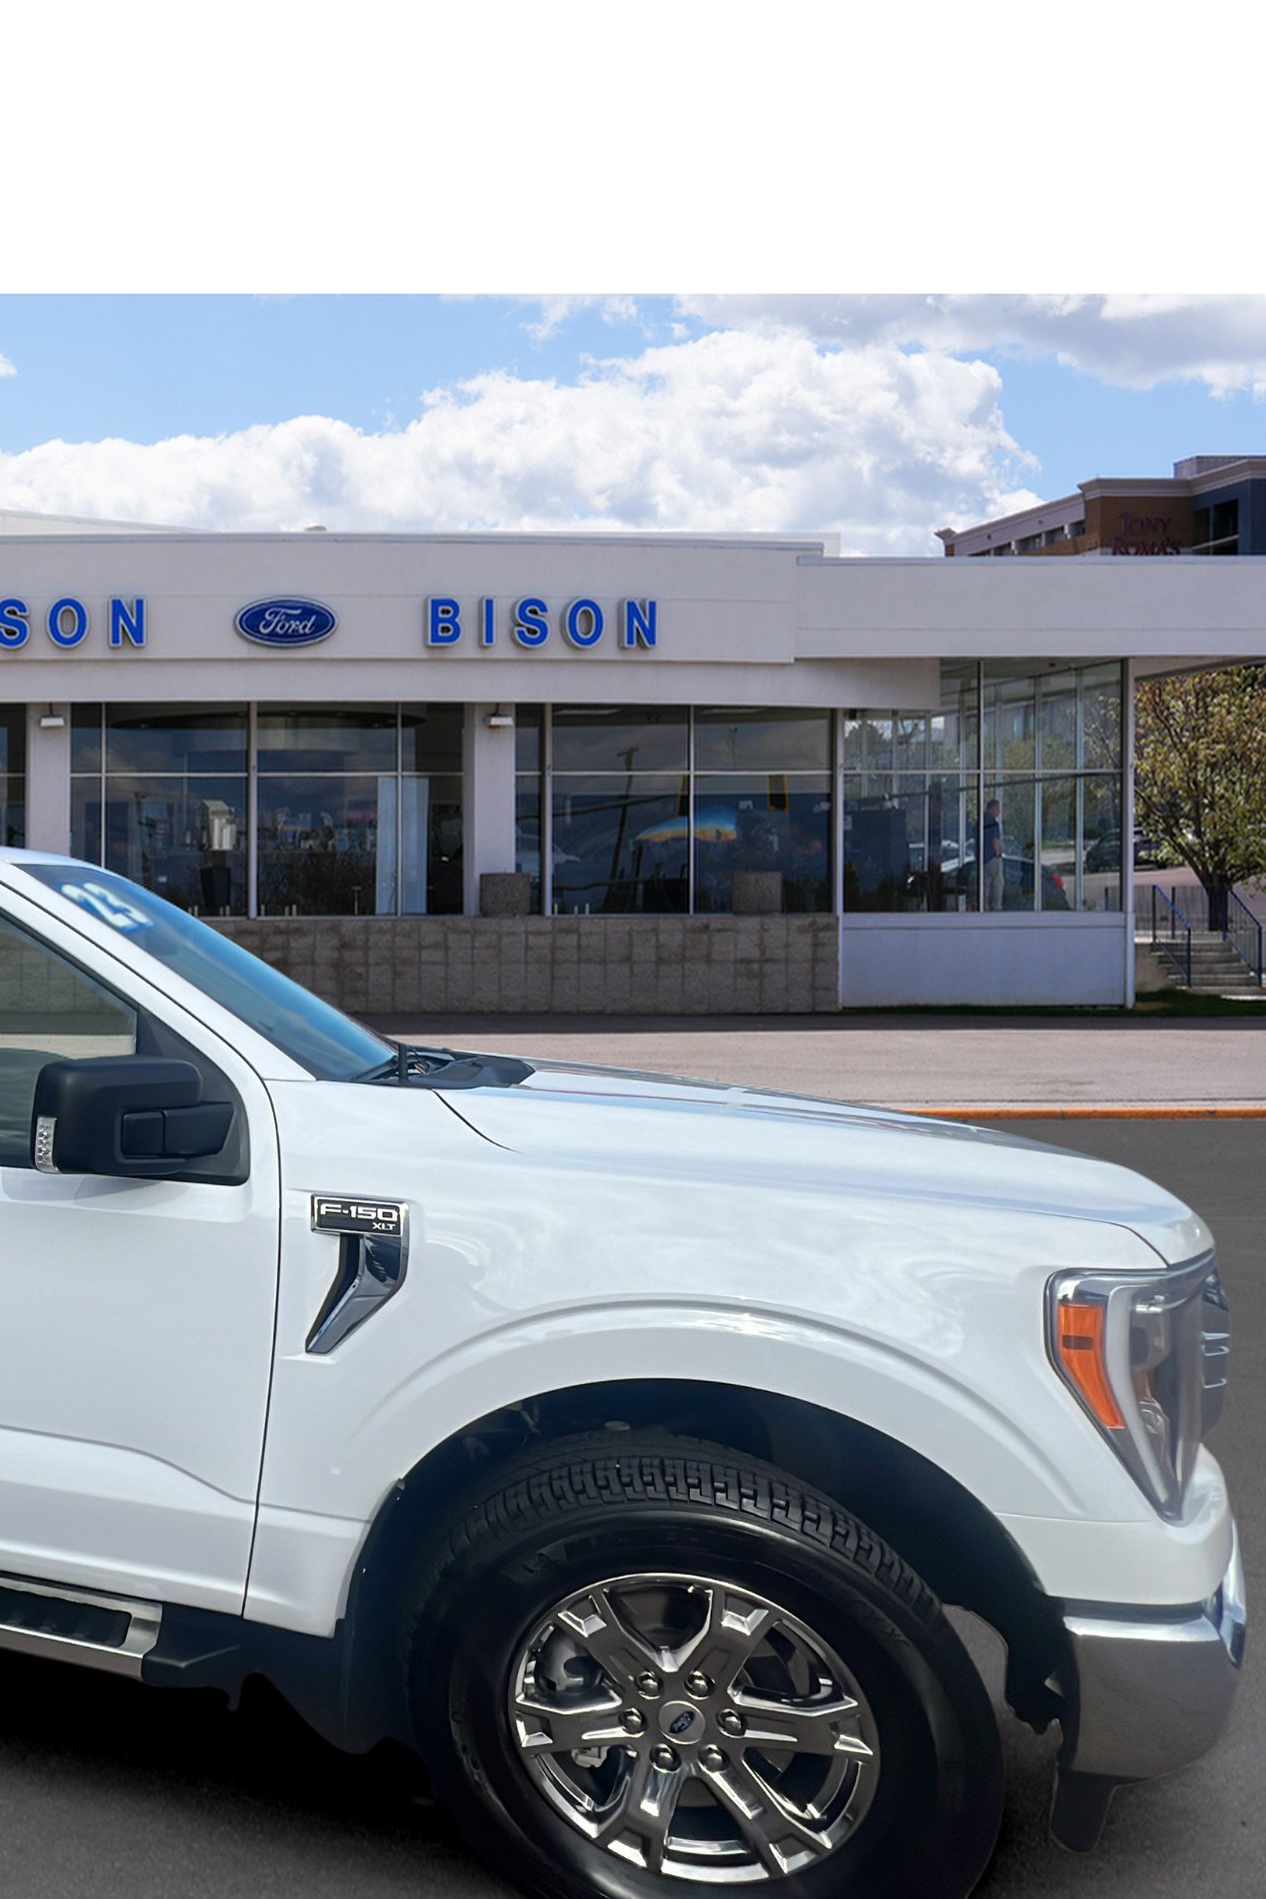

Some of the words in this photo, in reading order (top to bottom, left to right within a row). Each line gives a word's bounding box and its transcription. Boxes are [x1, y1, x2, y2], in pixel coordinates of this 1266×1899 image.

[1117, 512, 1172, 533] TONY
[258, 606, 317, 635] Ford
[424, 596, 658, 650] BISON
[60, 882, 154, 929] 23
[320, 1203, 399, 1222] F-150
[372, 1221, 396, 1231] XLT
